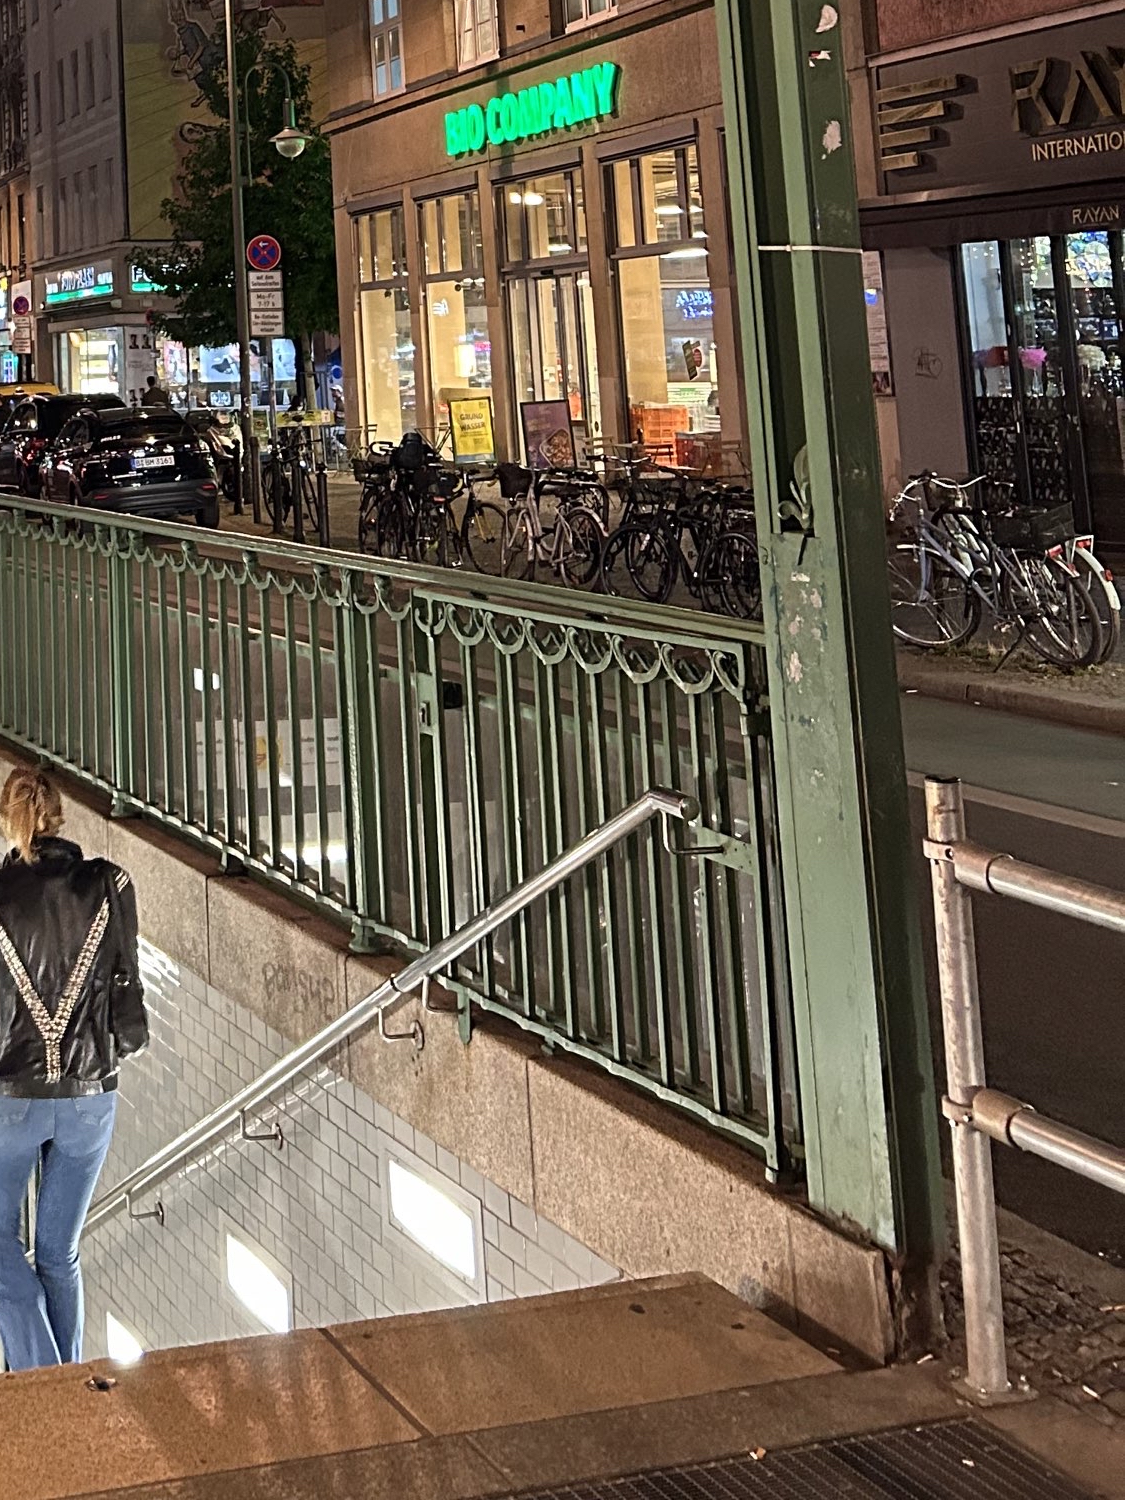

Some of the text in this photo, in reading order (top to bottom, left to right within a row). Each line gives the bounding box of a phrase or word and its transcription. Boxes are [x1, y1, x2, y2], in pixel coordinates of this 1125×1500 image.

[444, 61, 616, 156] BIO COMPANY
[1032, 130, 1125, 163] INTERNATIO
[1072, 205, 1120, 225] RAYAN
